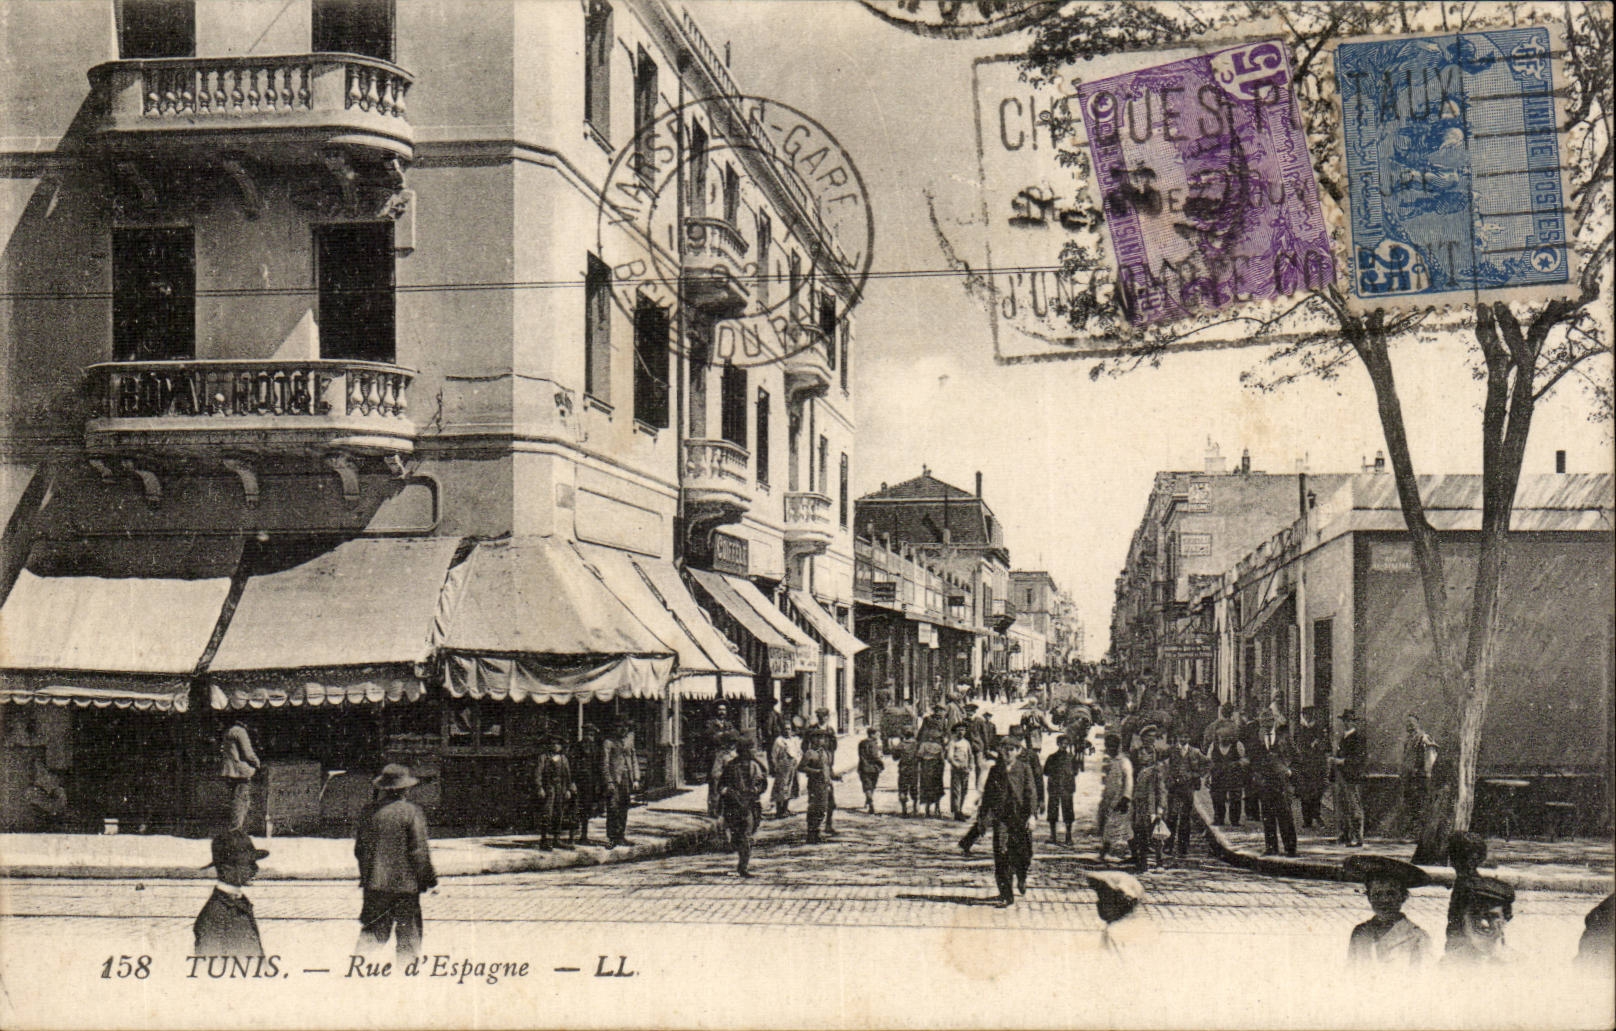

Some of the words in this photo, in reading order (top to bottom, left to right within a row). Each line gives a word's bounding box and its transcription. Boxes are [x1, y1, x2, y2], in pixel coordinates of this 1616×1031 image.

[1231, 42, 1285, 98] 15
[1521, 80, 1554, 157] TUNISIE
[1533, 169, 1561, 243] POSTES
[1357, 246, 1412, 294] 25
